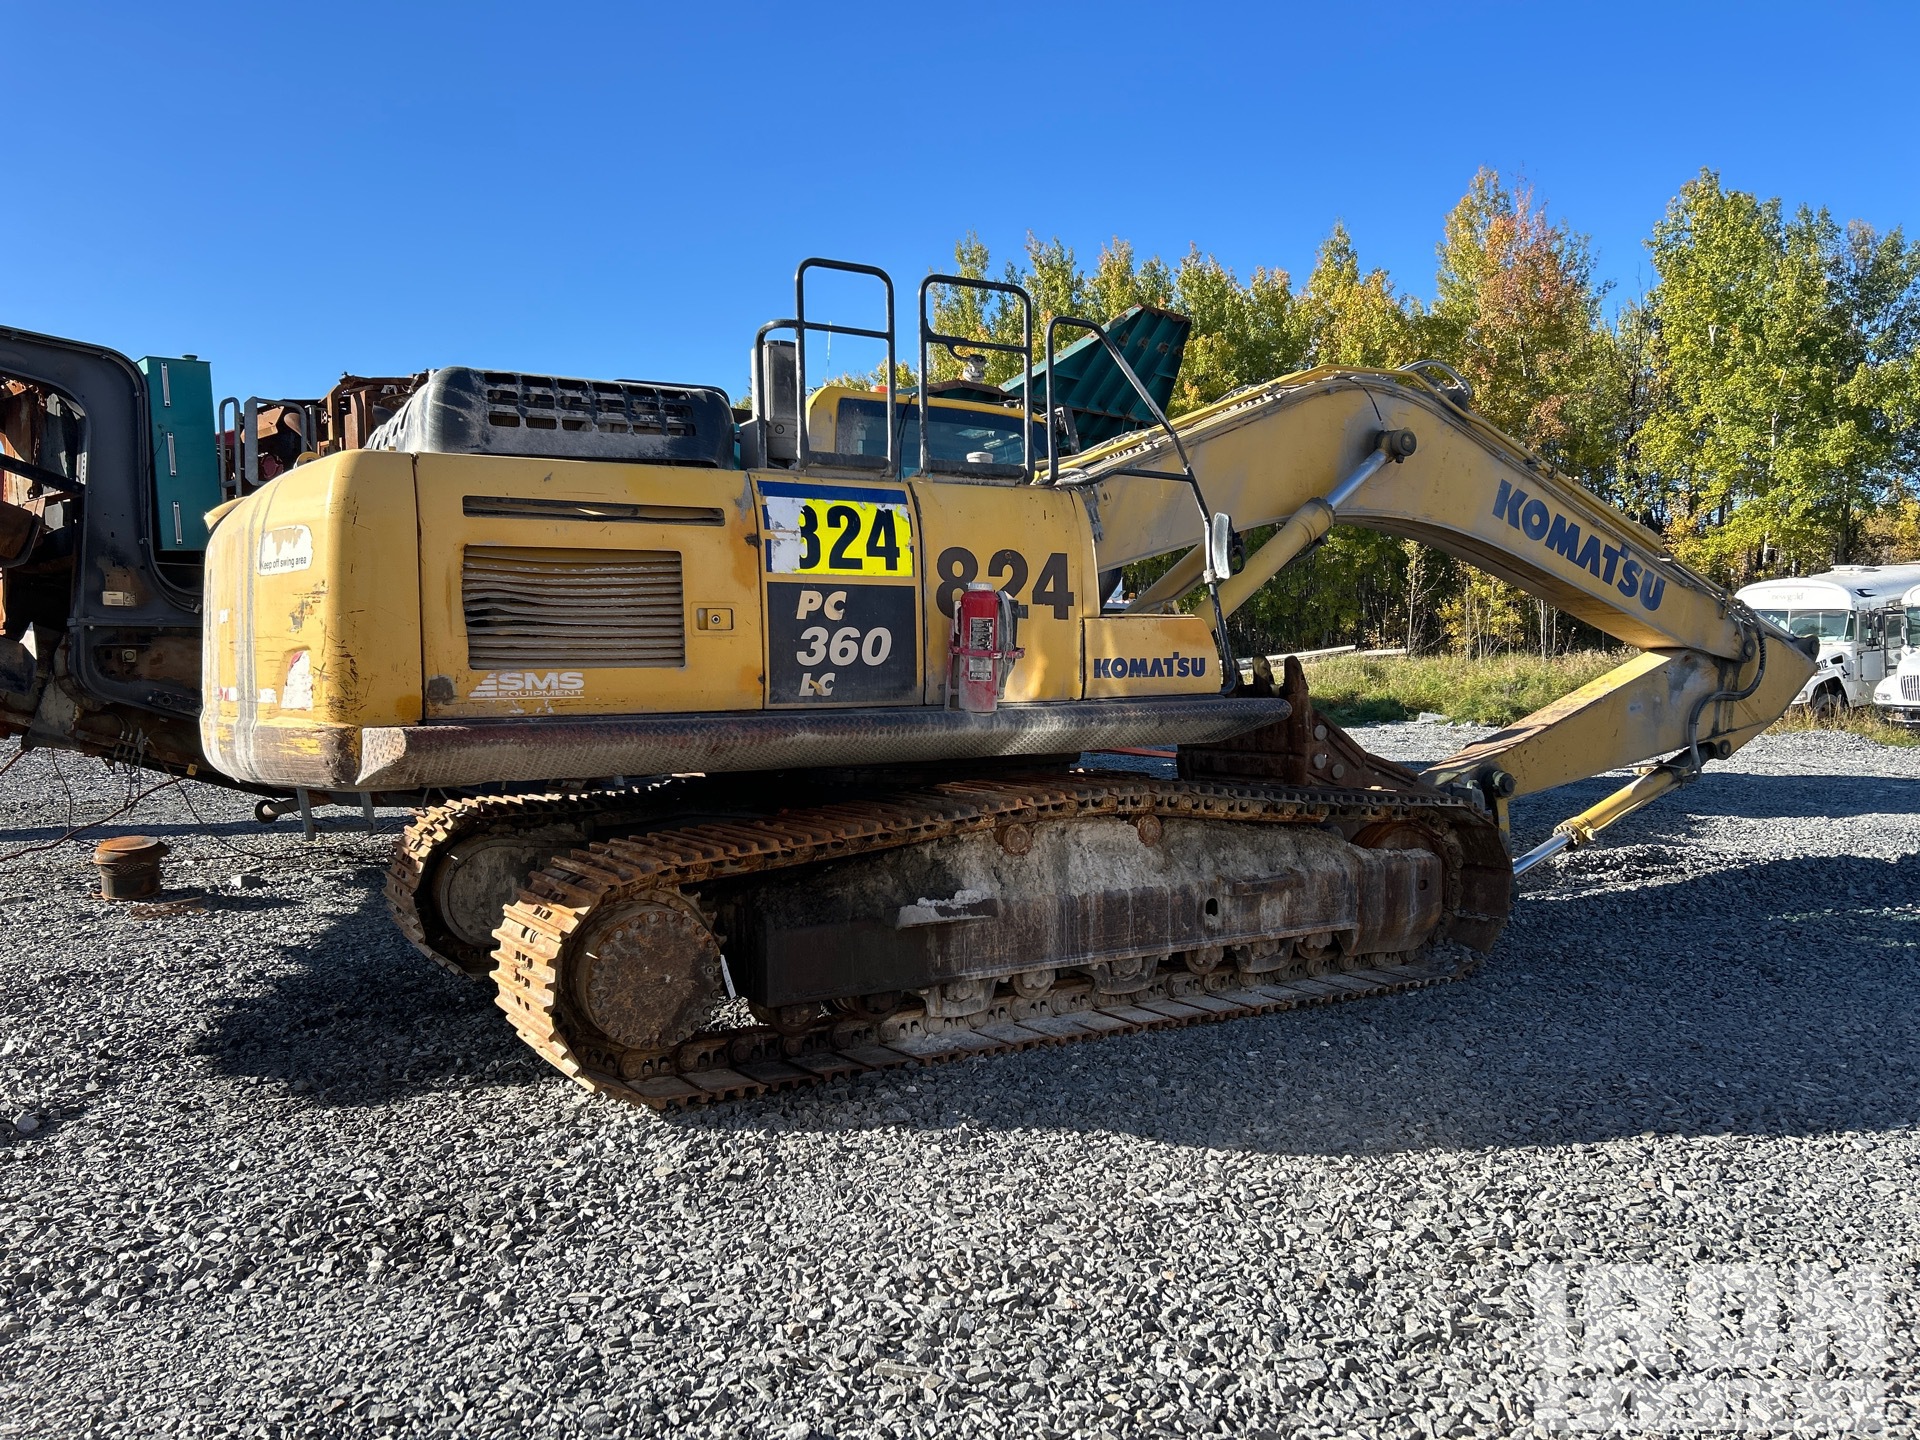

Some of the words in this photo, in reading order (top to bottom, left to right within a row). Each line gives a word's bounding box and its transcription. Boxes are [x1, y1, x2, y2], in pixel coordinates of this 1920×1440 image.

[1492, 478, 1667, 612] KOMATSU
[280, 557, 294, 568] swing
[936, 546, 1075, 620] 824
[796, 590, 848, 621] PC
[796, 626, 892, 666] 360
[1093, 652, 1206, 678] KOMATSU
[498, 671, 585, 690] SMS
[798, 672, 836, 697] LC
